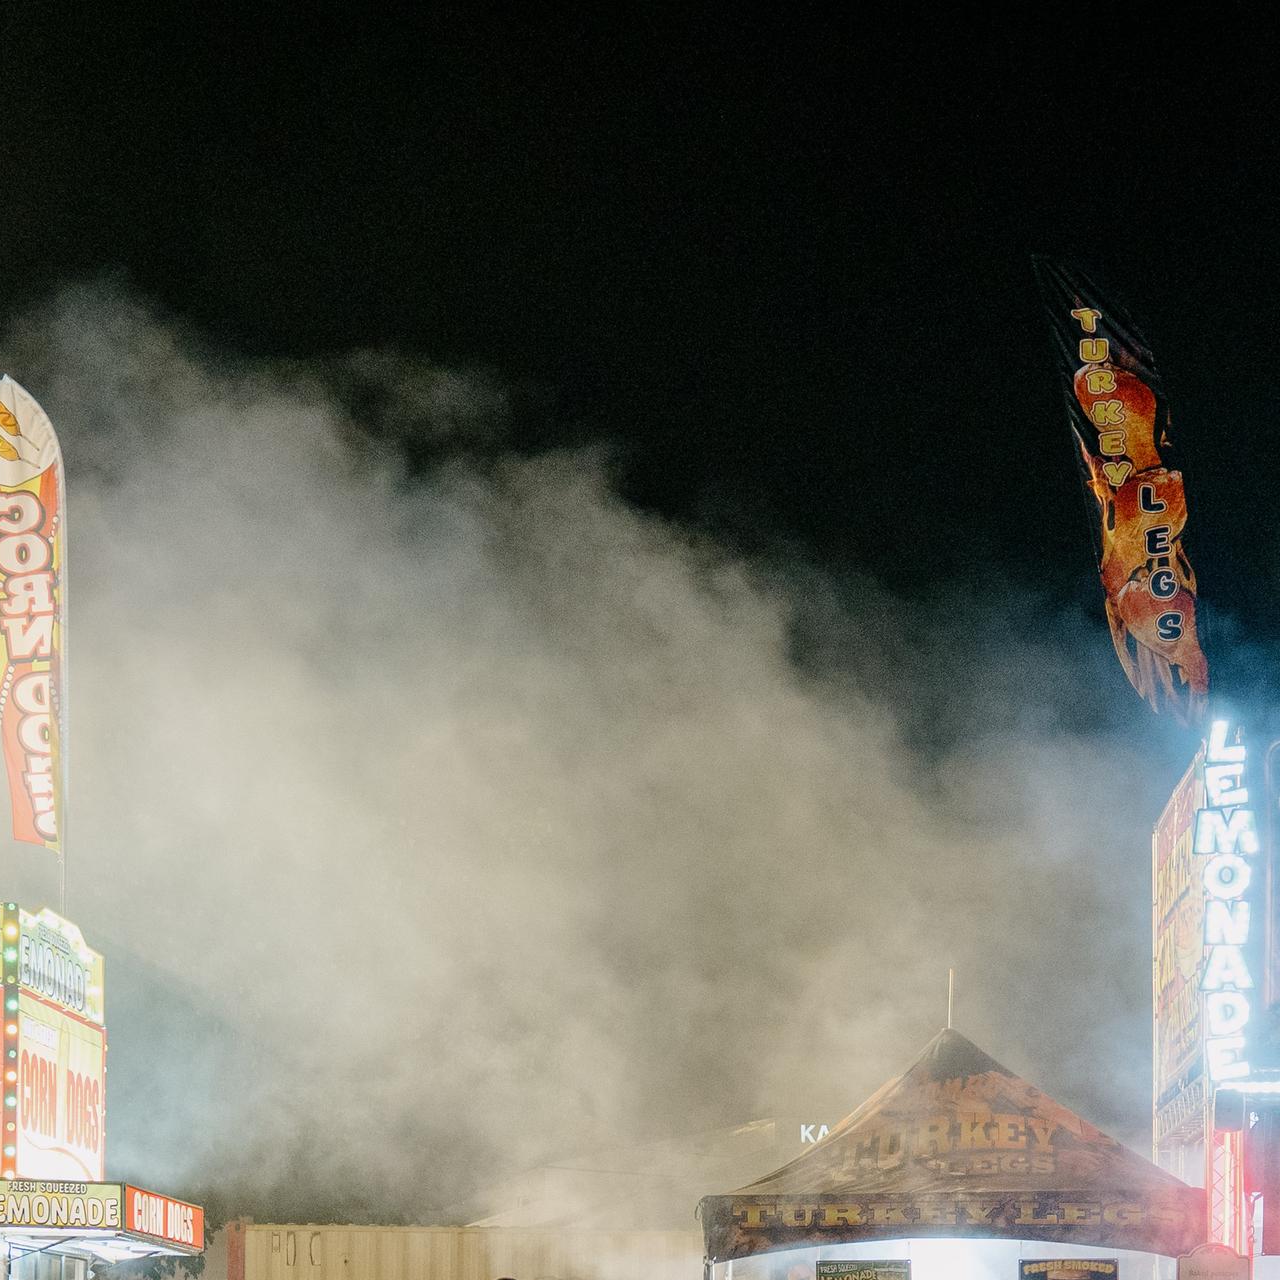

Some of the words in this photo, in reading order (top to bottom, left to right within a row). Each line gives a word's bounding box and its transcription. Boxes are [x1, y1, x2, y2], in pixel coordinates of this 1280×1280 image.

[1071, 308, 1134, 488] TURKEY
[1137, 482, 1184, 643] LEGS
[1192, 719, 1260, 1082] LEMONADE
[22, 934, 94, 1016] EMONAD
[21, 1048, 58, 1139] CORN
[66, 1068, 100, 1154] DOGS
[832, 1112, 1058, 1178] TURKEY
[7, 1181, 36, 1194] FRESH
[40, 1181, 87, 1195] SQUEEZED
[133, 1191, 164, 1237] CORN
[167, 1202, 194, 1244] DOGS
[732, 1200, 1002, 1230] TURKEY
[1014, 1200, 1183, 1229] LEGS
